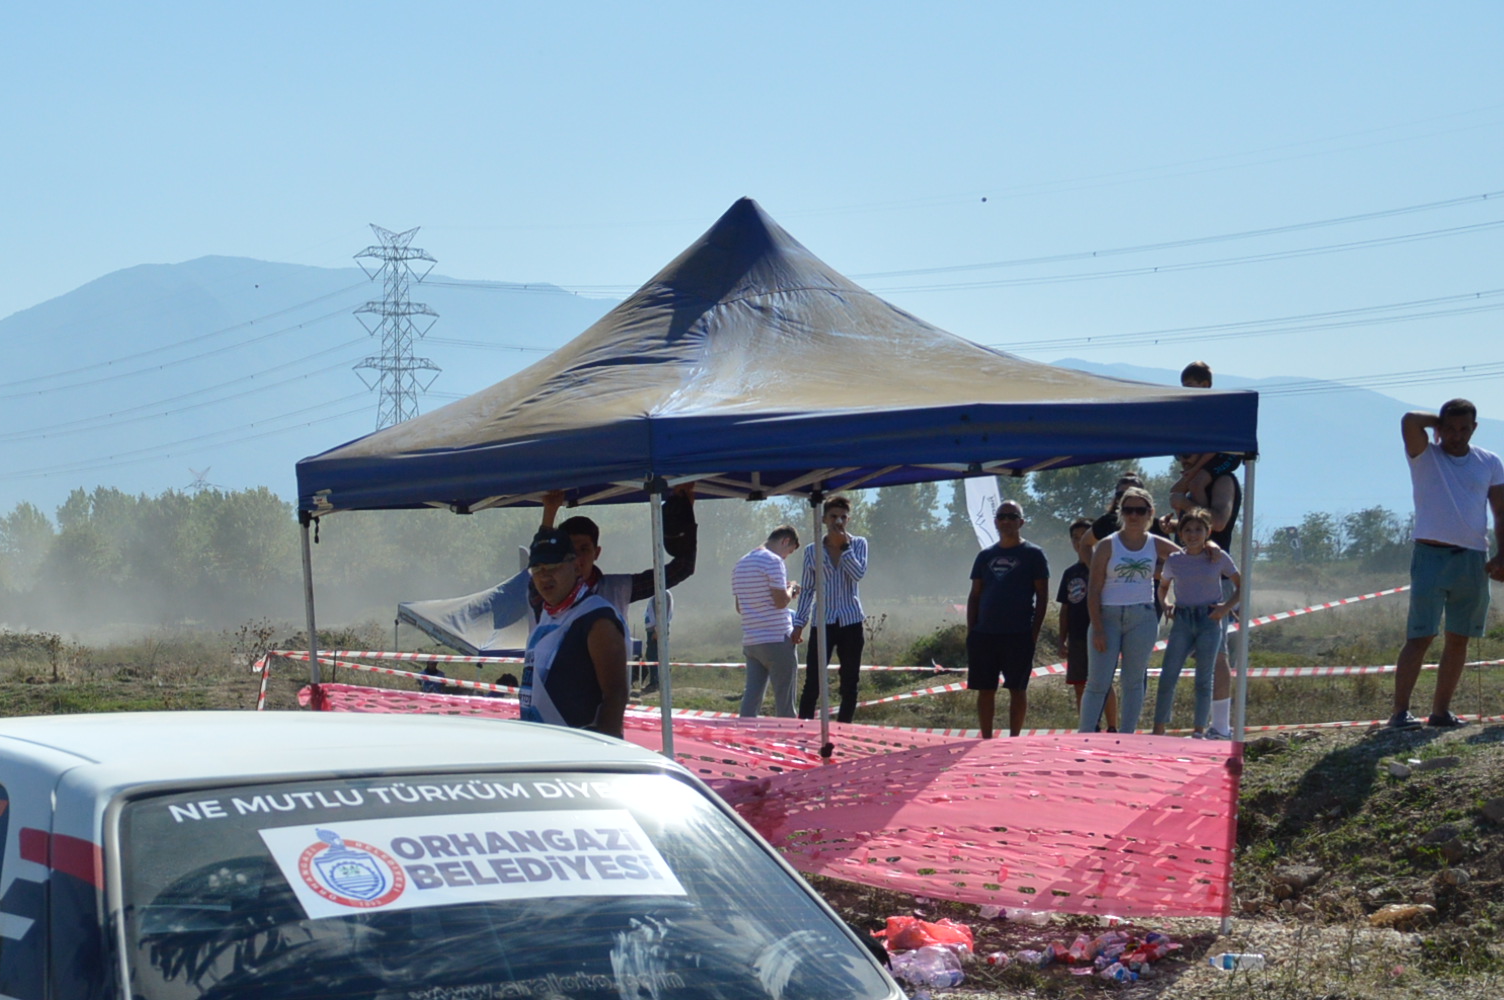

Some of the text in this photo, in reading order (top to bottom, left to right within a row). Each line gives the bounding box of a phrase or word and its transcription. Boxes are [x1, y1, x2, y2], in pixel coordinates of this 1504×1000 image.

[168, 778, 614, 823] NE MUTLU TÜRKÜM DİYE
